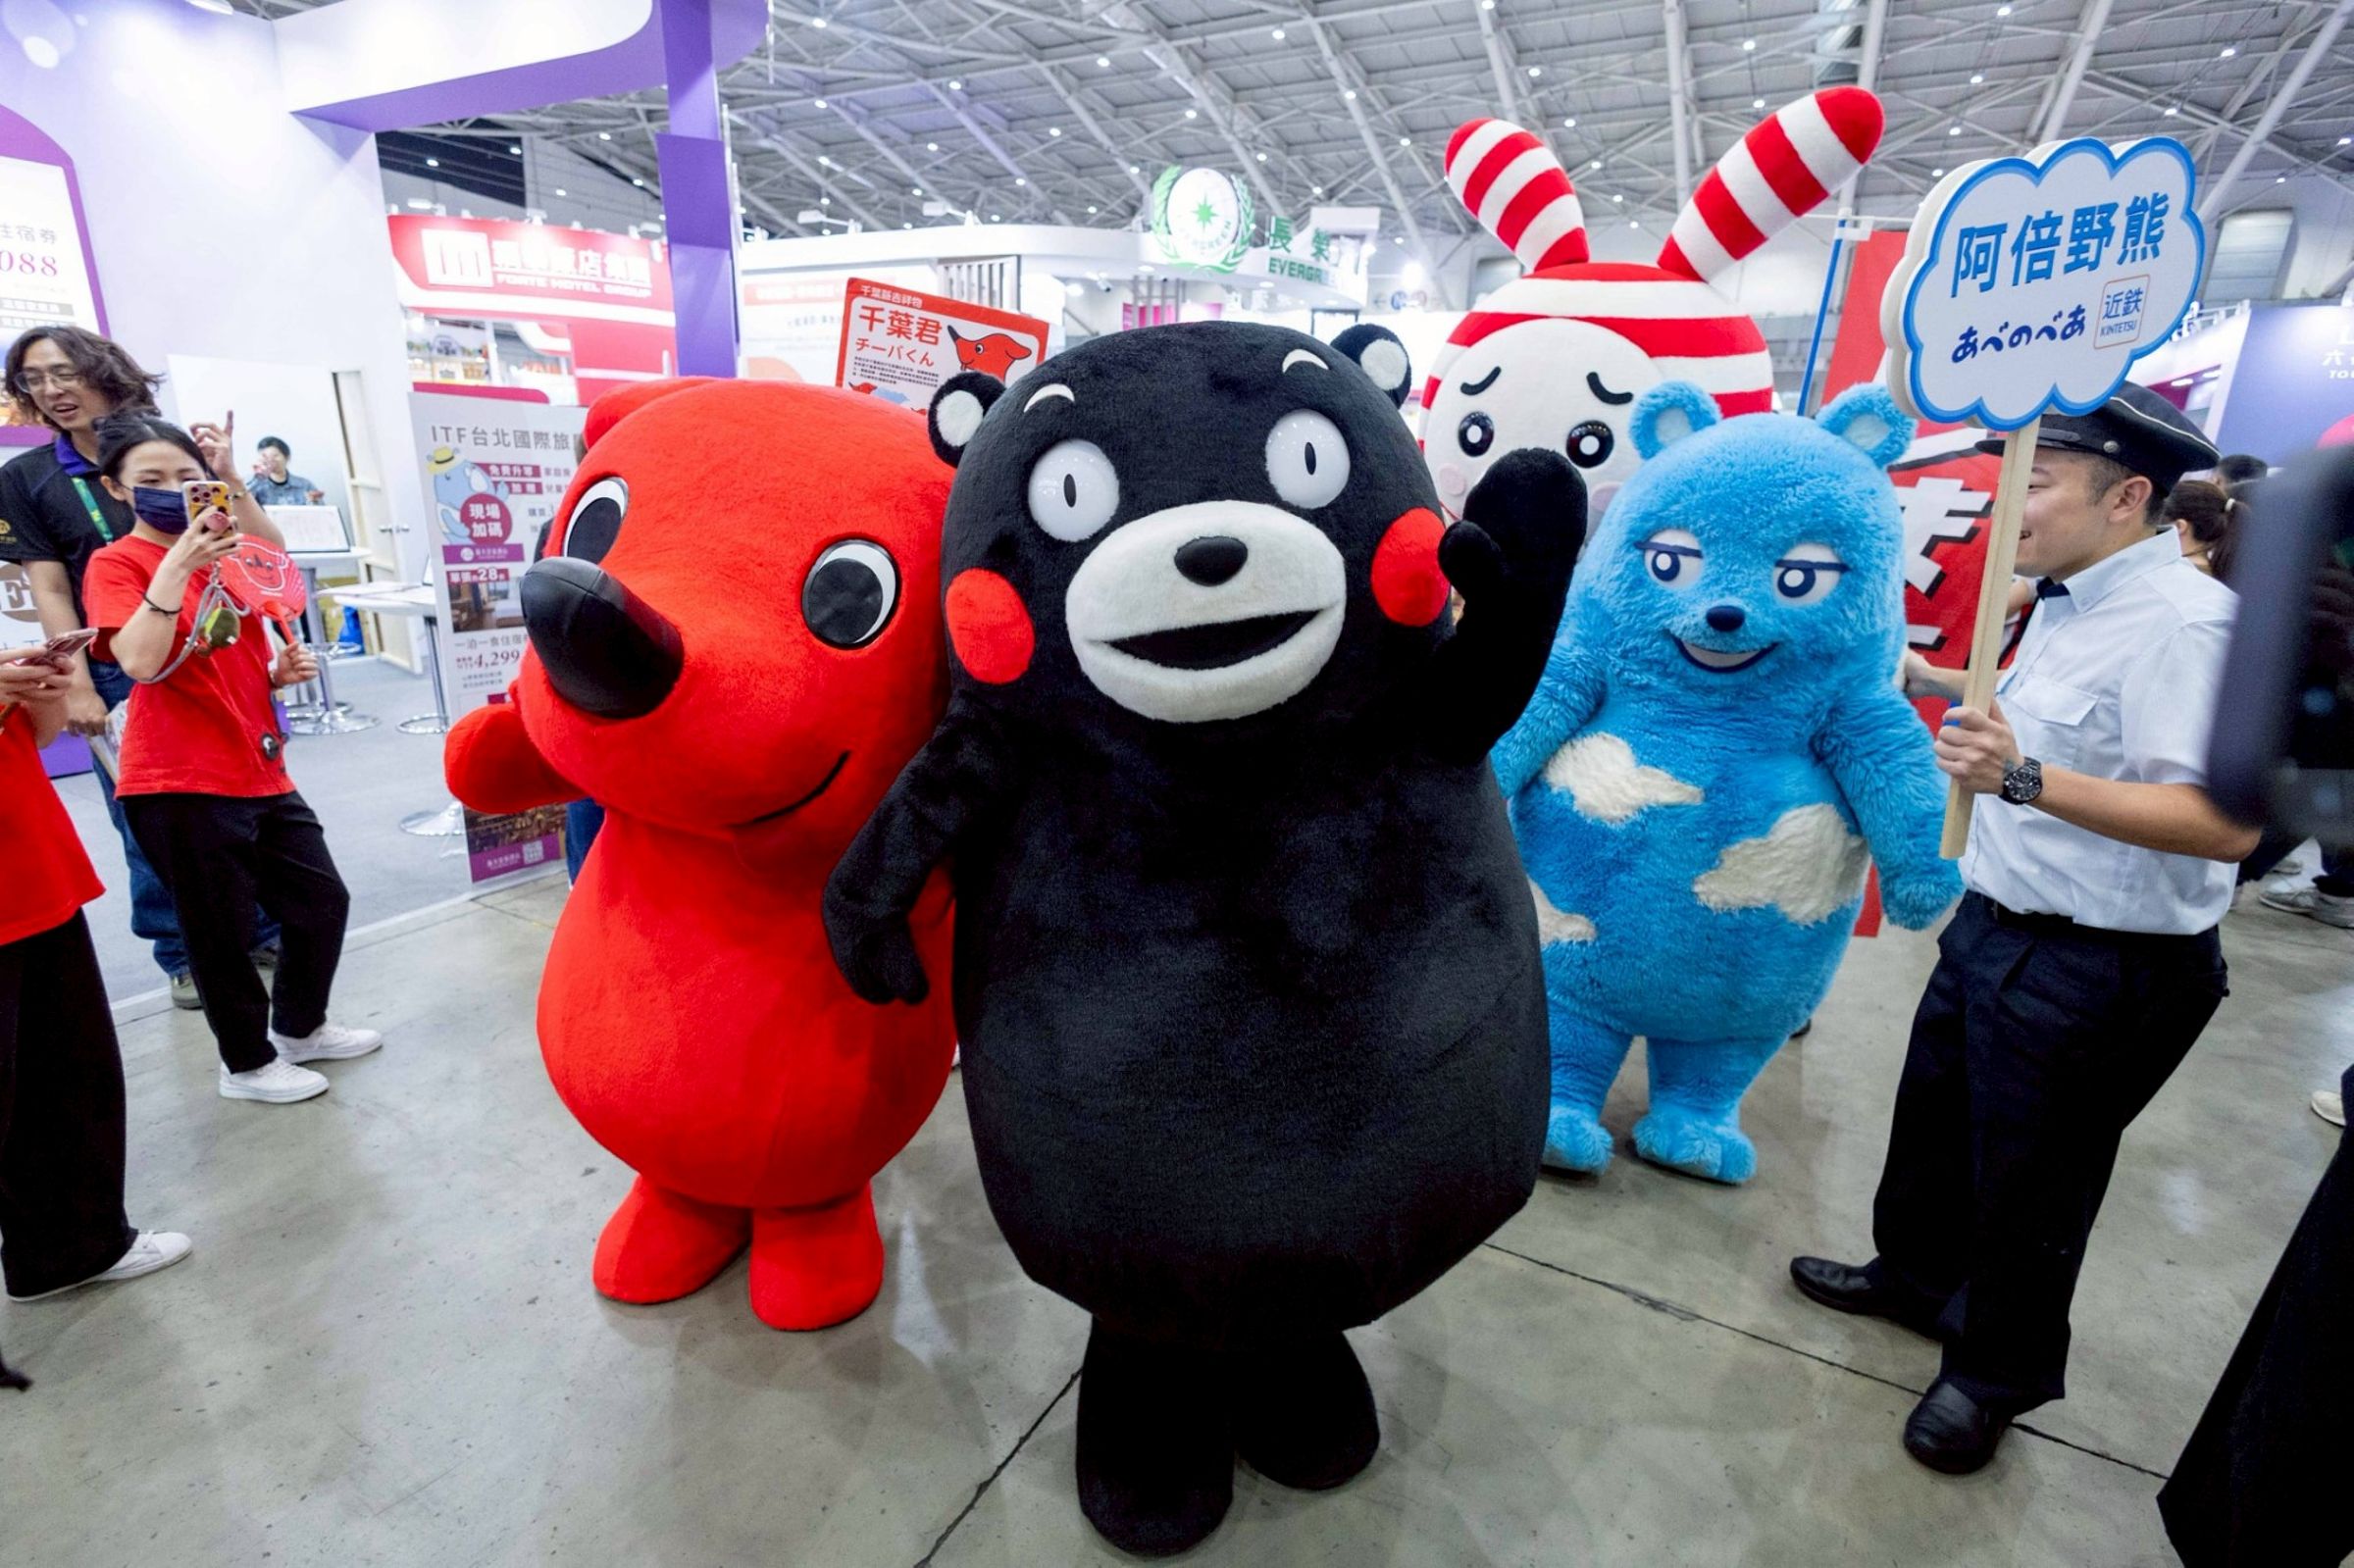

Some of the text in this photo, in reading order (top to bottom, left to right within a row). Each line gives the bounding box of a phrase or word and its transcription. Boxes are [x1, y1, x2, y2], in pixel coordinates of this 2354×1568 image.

[1950, 191, 2171, 299] 阿倍野熊
[2101, 287, 2144, 320] 近鉄
[858, 304, 943, 346] 千葉君
[1951, 303, 2086, 364] あべのべあ
[2100, 319, 2137, 336] KINTETSU
[855, 336, 935, 369] チーバくん
